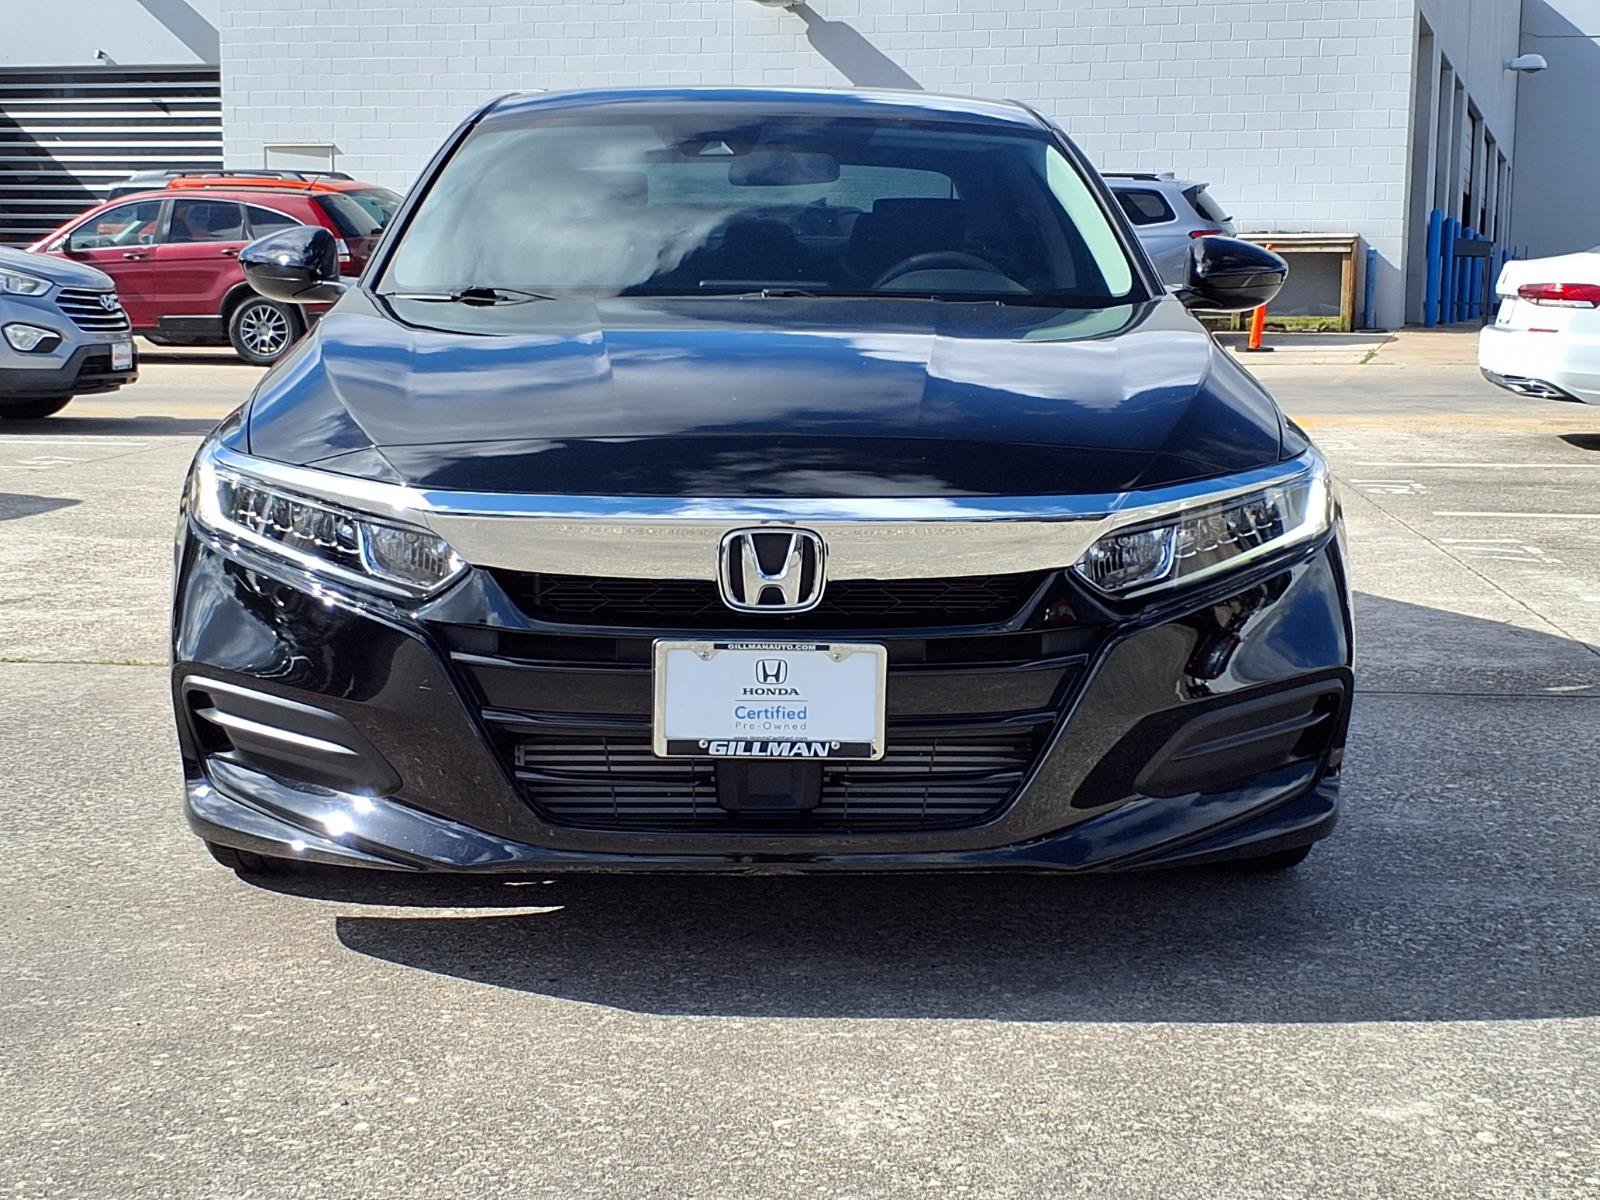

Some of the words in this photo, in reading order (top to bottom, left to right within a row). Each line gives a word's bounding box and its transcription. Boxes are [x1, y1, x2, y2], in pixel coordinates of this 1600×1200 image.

[727, 643, 817, 651] GILLMANAUTO.COM
[741, 687, 801, 696] HONDA
[734, 705, 808, 720] Certified
[735, 721, 808, 730] Pre-Owned
[708, 740, 830, 757] GILLMAN
